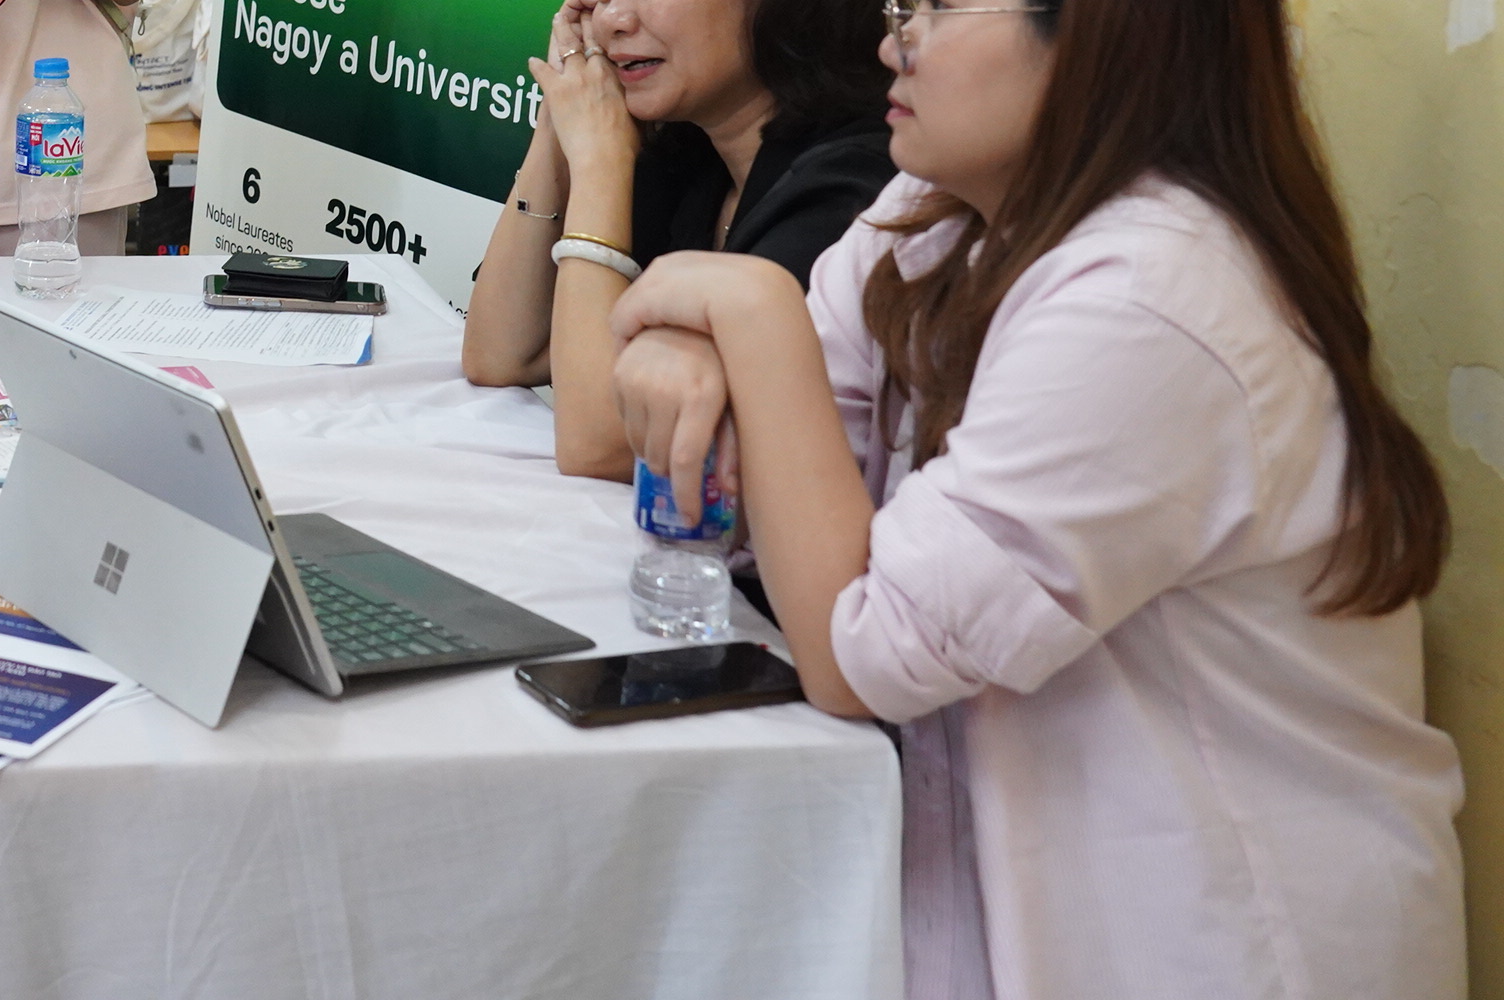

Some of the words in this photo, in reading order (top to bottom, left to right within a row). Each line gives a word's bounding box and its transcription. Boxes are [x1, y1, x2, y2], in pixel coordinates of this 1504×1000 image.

[339, 39, 359, 75] a
[369, 35, 543, 129] Universit
[242, 167, 261, 204] 6
[206, 202, 235, 229] Nobel
[238, 215, 294, 253] Laureates
[325, 198, 427, 265] 2500+
